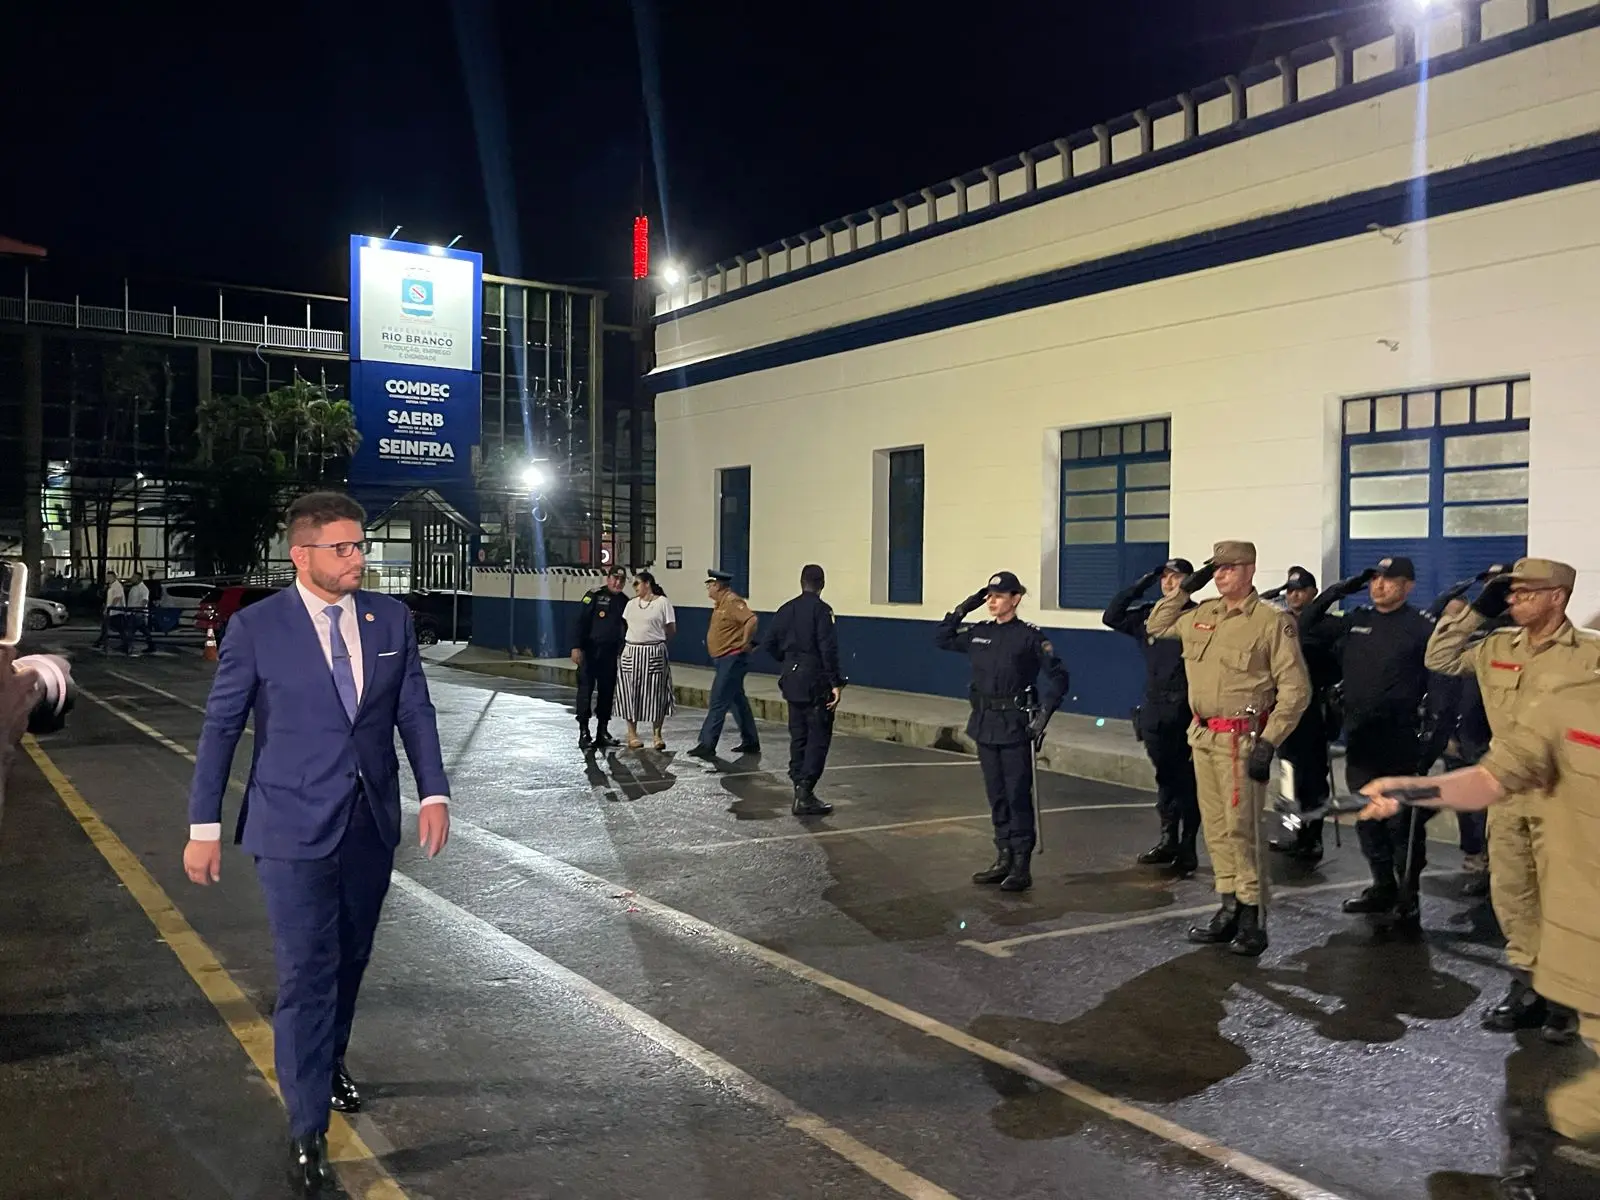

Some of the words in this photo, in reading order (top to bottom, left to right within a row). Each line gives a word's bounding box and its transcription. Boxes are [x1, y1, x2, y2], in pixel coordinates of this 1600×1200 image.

[382, 332, 402, 342] RIO
[406, 335, 453, 347] BRANCO
[385, 379, 450, 398] COMDEC
[387, 410, 445, 427] SAERB
[379, 438, 455, 458] SEINFRA
